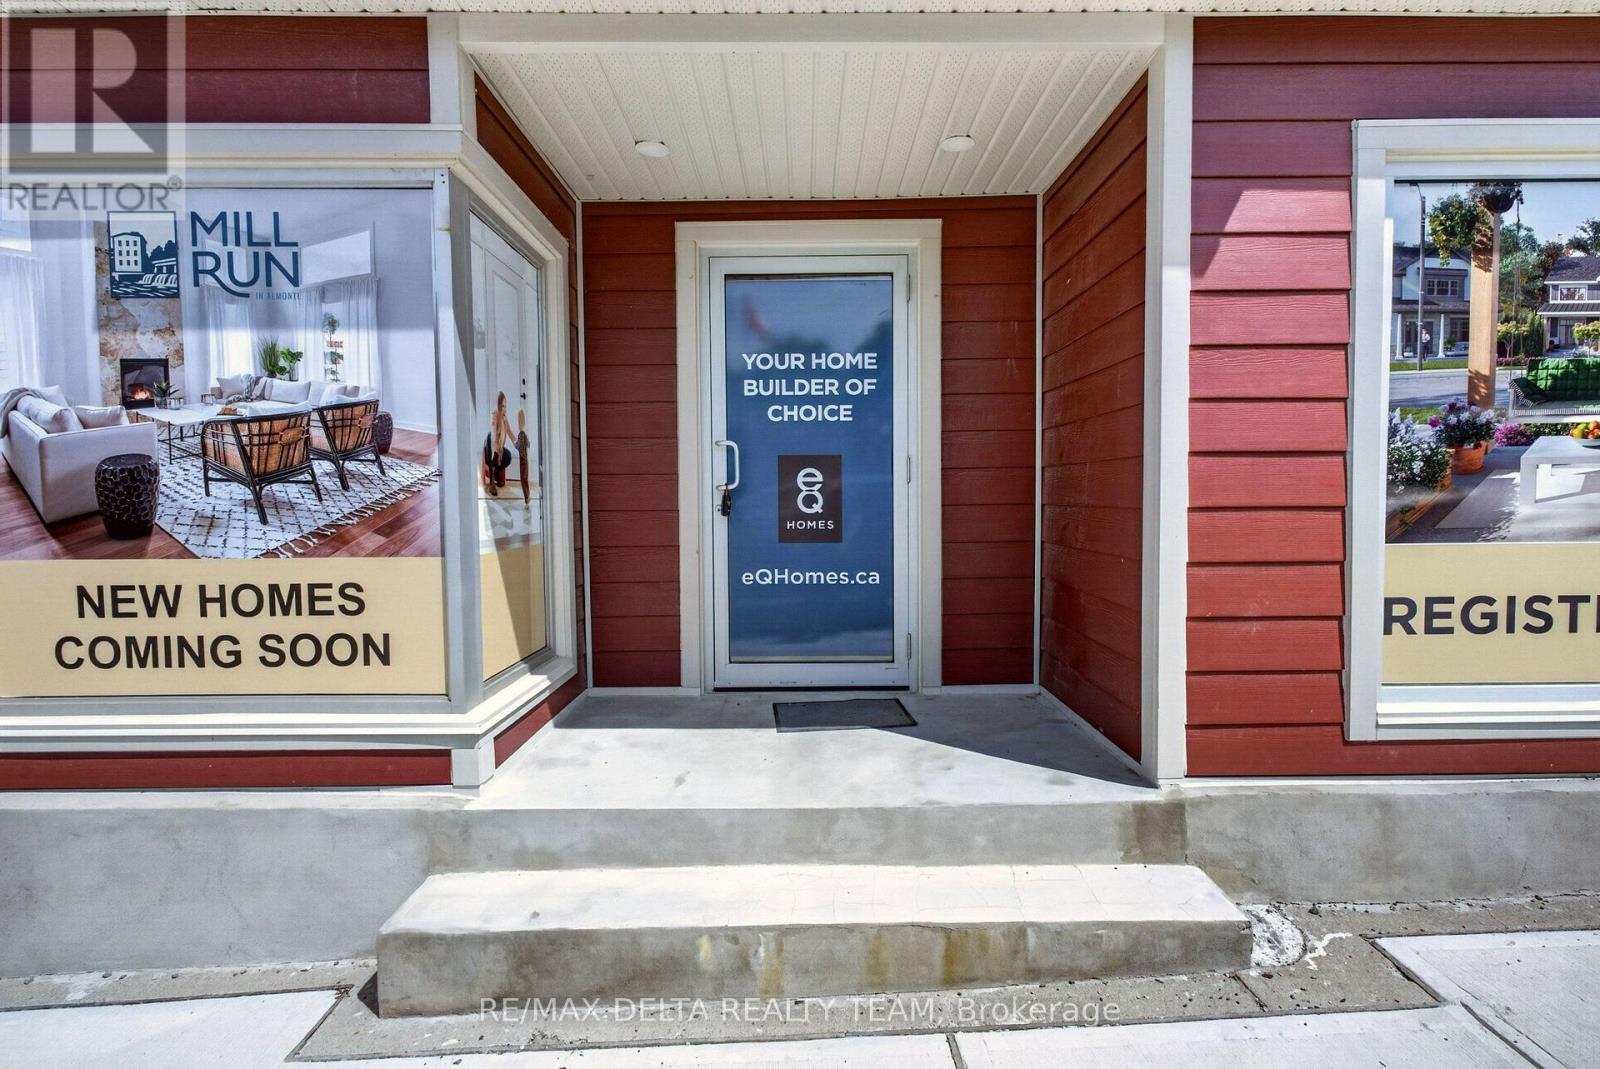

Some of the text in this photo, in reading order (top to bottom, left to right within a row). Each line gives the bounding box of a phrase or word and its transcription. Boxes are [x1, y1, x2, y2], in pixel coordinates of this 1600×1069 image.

[190, 211, 299, 247] MILL
[192, 251, 300, 298] RUN
[742, 353, 877, 369] YOUR HOME
[743, 379, 877, 396] BUILDER OF
[767, 405, 853, 422] CHOICE
[786, 520, 834, 529] HOMES
[742, 568, 880, 585] eQHomes.ca
[76, 582, 366, 619] NEW HOMES
[1383, 594, 1600, 636] REGIST
[54, 633, 392, 669] COMING SOON
